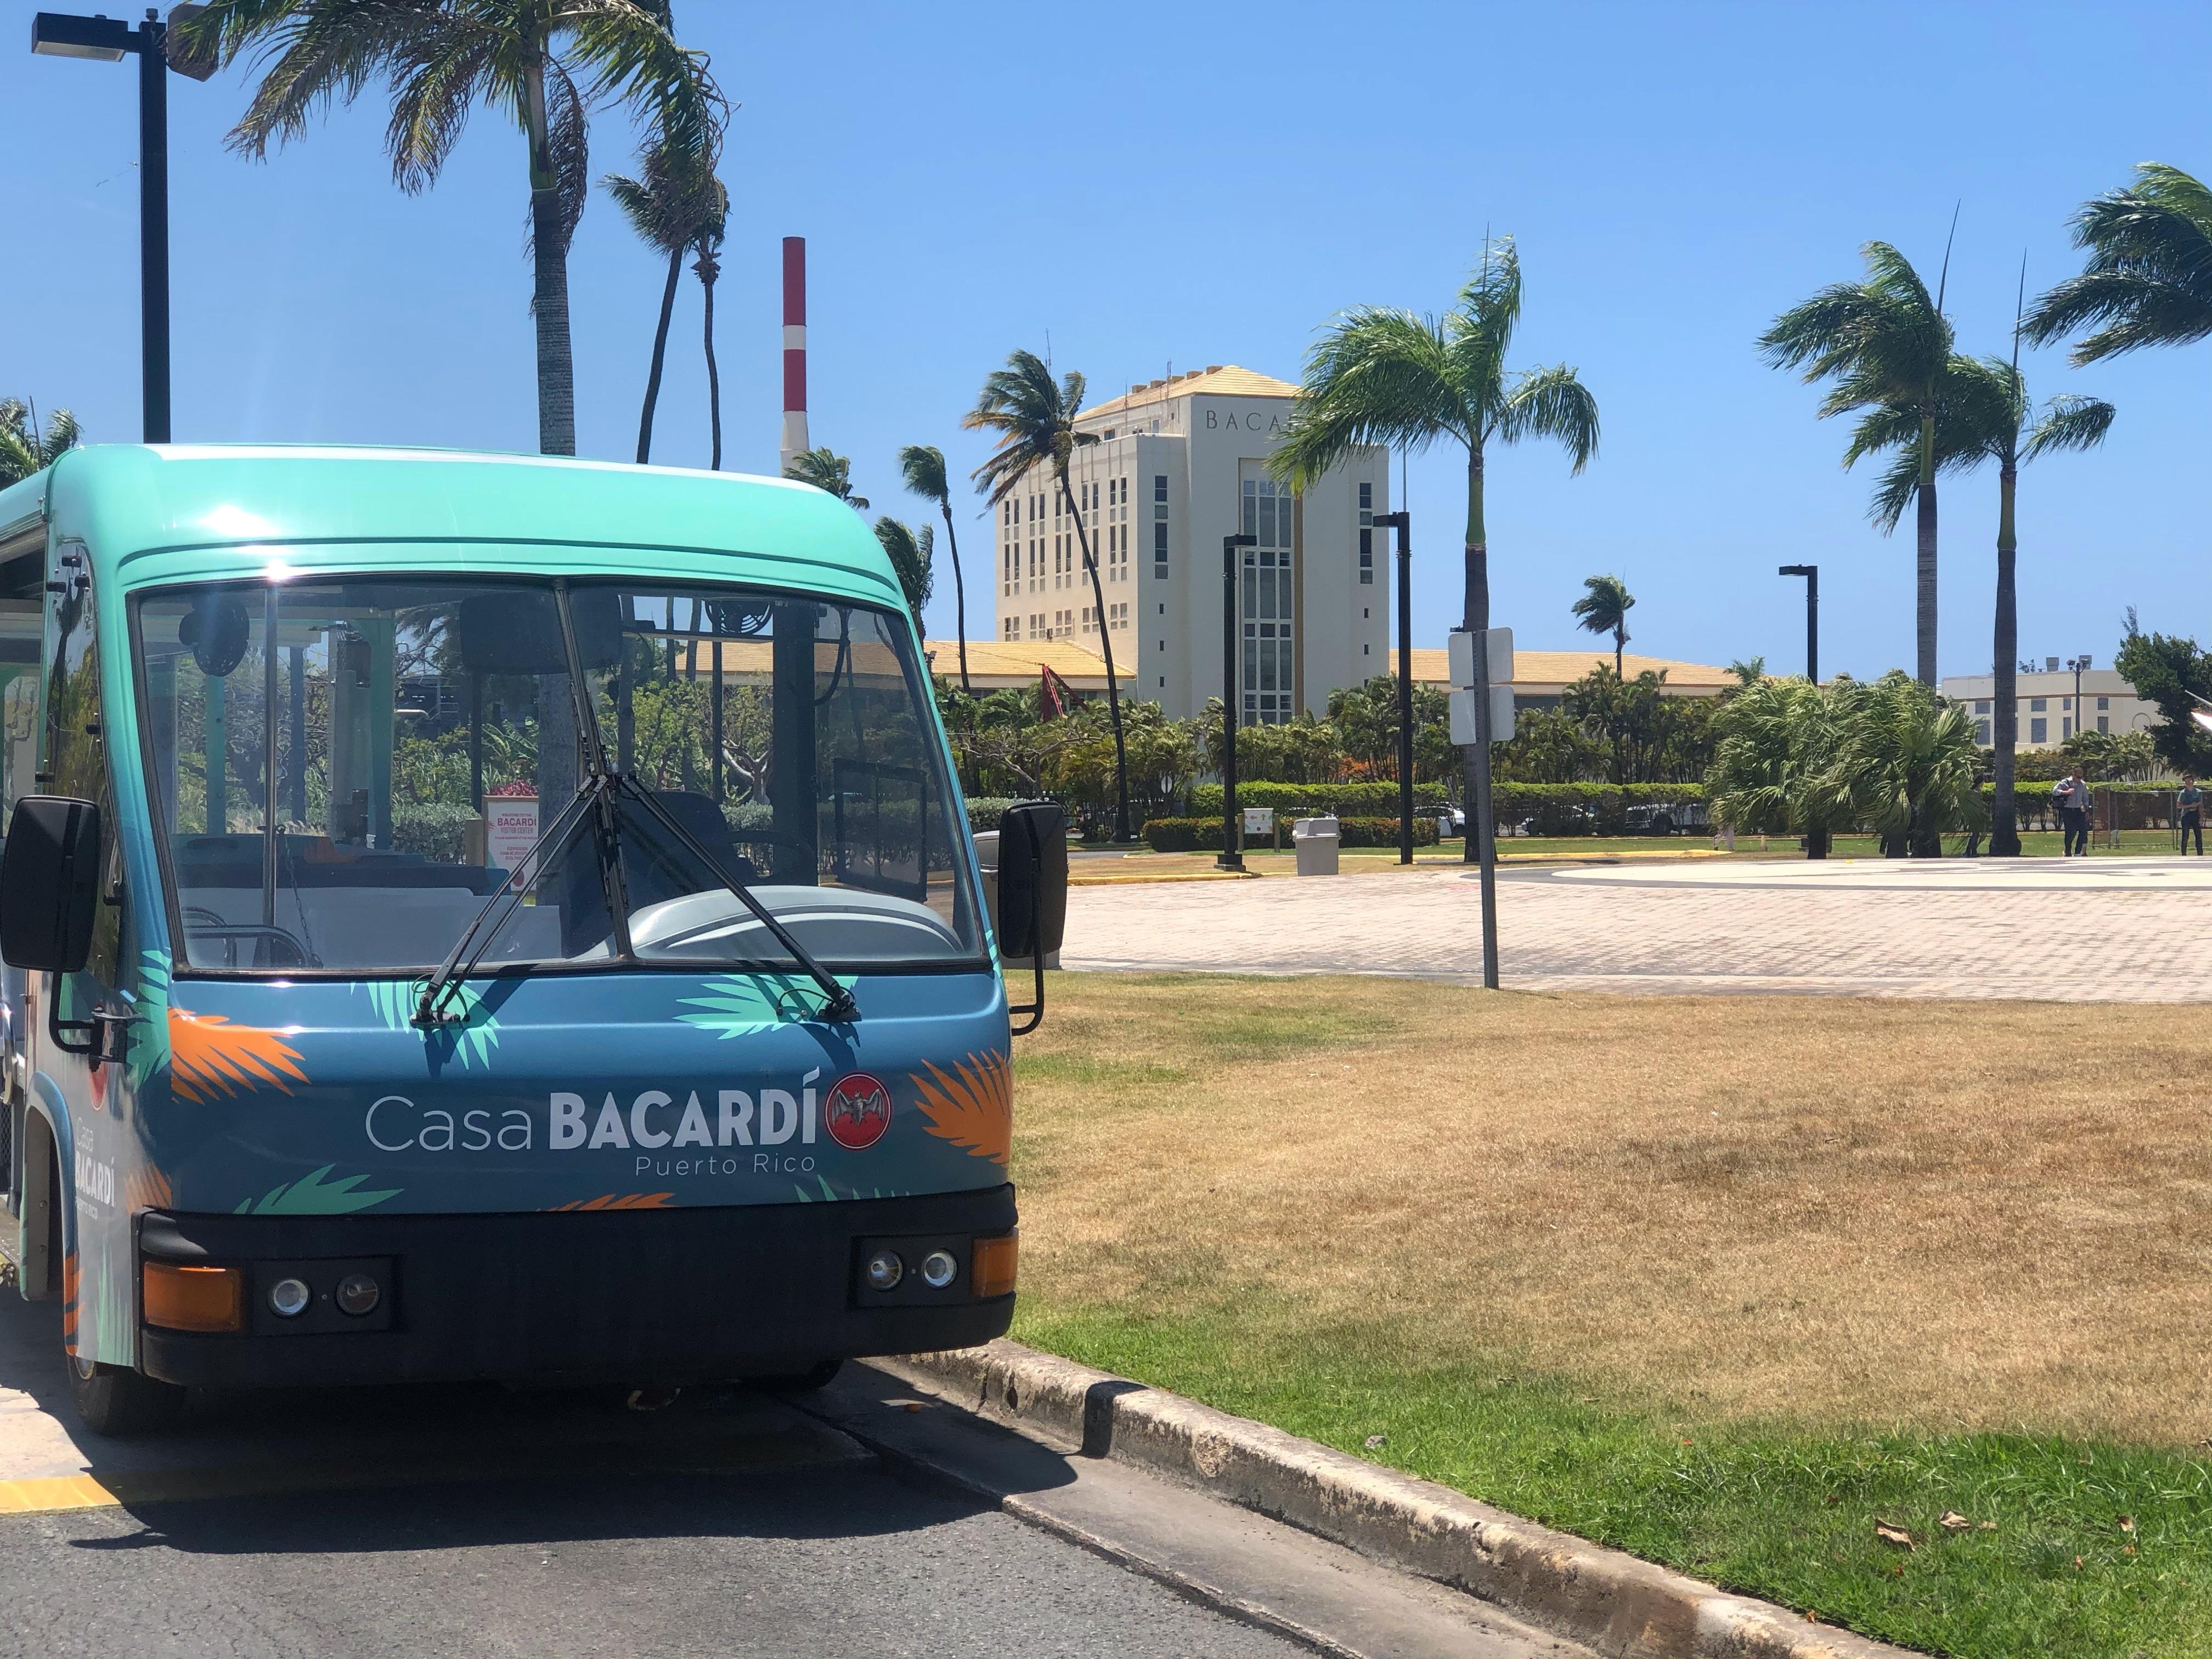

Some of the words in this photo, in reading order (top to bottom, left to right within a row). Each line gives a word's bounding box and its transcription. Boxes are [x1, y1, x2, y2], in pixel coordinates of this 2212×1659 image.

[365, 1095, 533, 1151] Casa
[549, 1065, 820, 1149] BACARDÍ
[76, 1117, 93, 1152] Casa
[75, 1150, 115, 1207] BACARDÍ
[635, 1155, 737, 1177] Puerto
[753, 1153, 816, 1175] Rico
